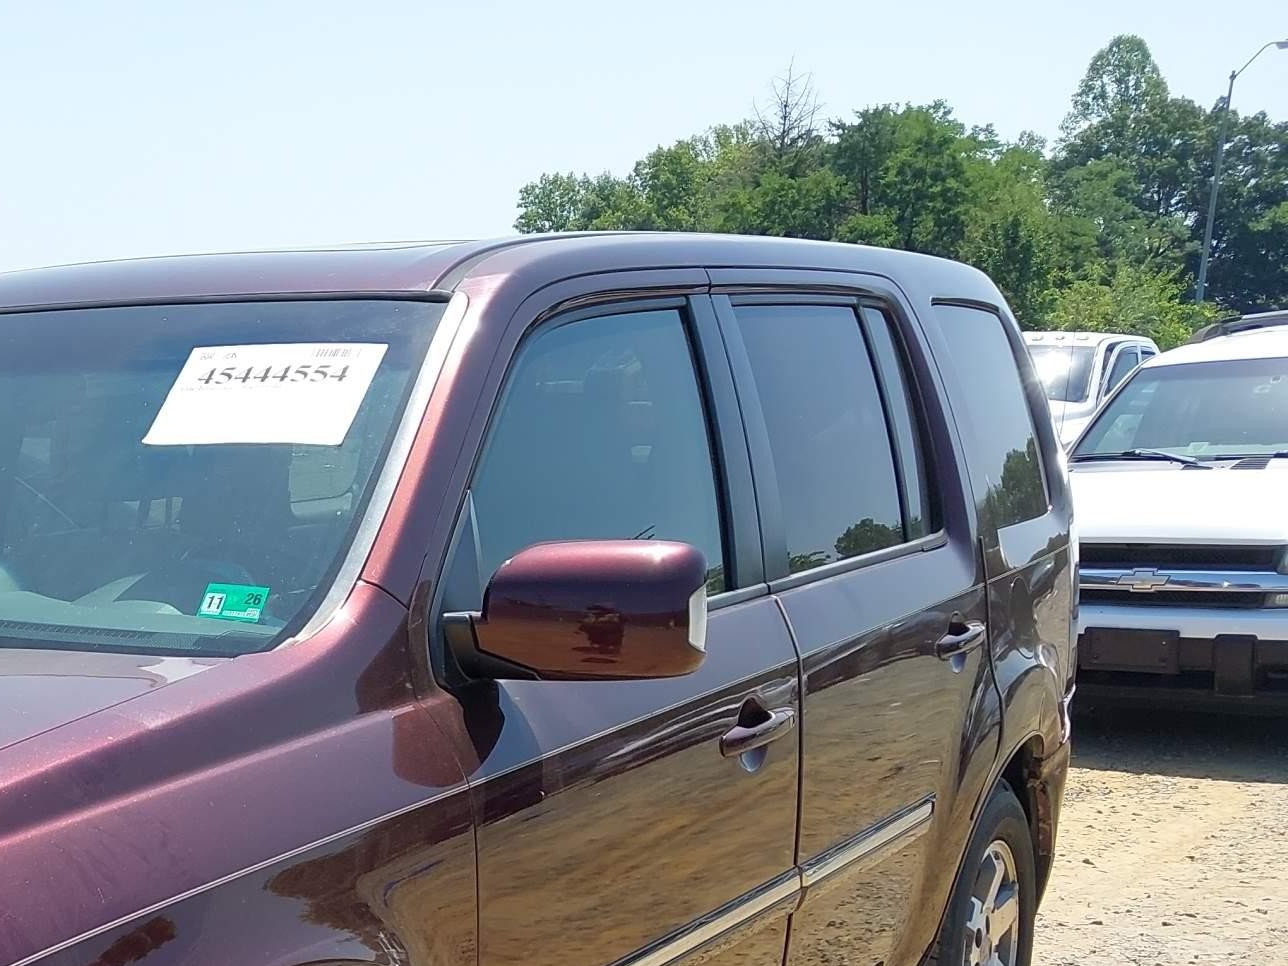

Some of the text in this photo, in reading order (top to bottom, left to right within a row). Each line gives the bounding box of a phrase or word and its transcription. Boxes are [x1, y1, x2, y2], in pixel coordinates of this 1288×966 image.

[197, 364, 350, 385] 45444554
[207, 595, 224, 610] 11
[244, 592, 263, 606] 26
